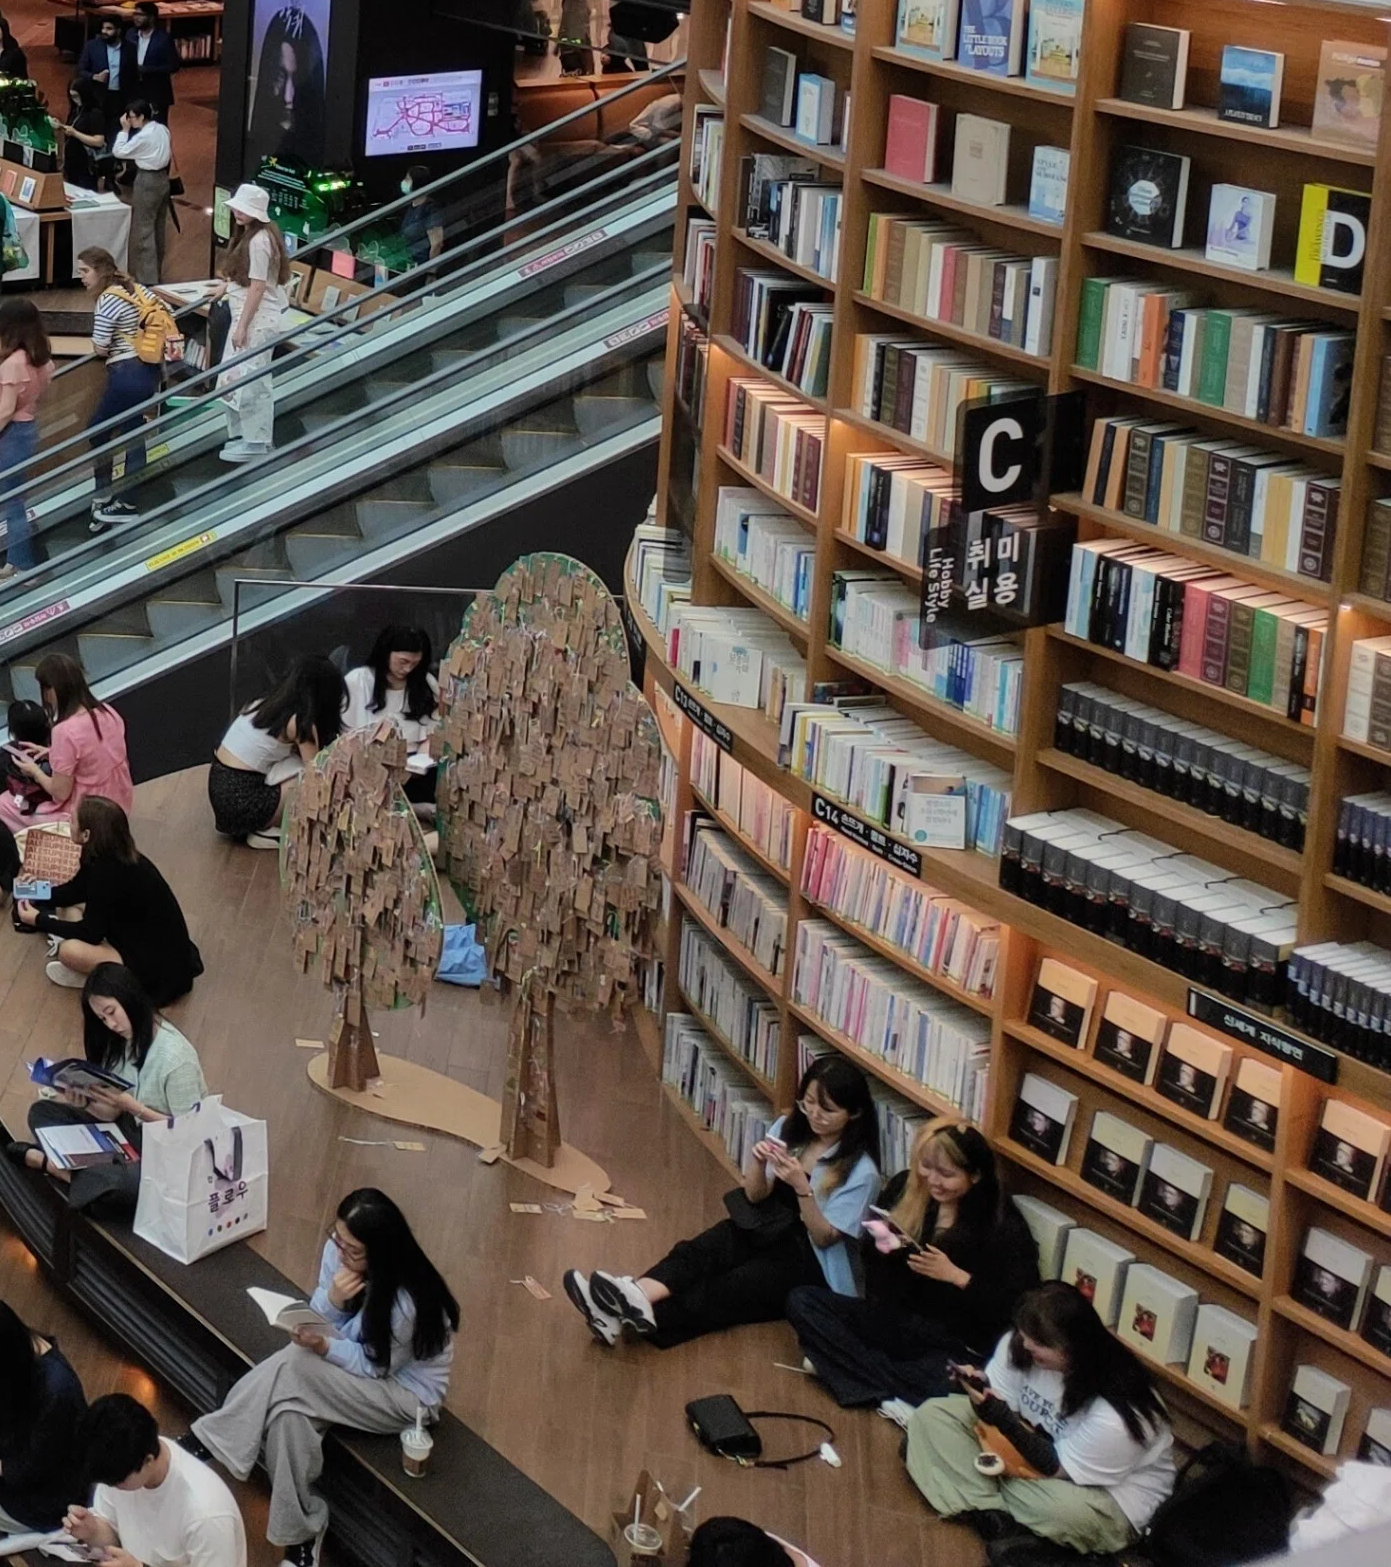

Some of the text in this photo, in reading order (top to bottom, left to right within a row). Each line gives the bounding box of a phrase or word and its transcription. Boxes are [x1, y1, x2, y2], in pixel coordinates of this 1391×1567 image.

[979, 418, 1024, 493] C
[967, 533, 1020, 569] 취미
[924, 547, 940, 624] Life Style
[938, 557, 955, 609] Hobby
[965, 572, 1019, 610] 실용
[815, 798, 840, 826] C14
[1223, 1014, 1256, 1038] 신세계
[208, 1180, 249, 1213] 플로우
